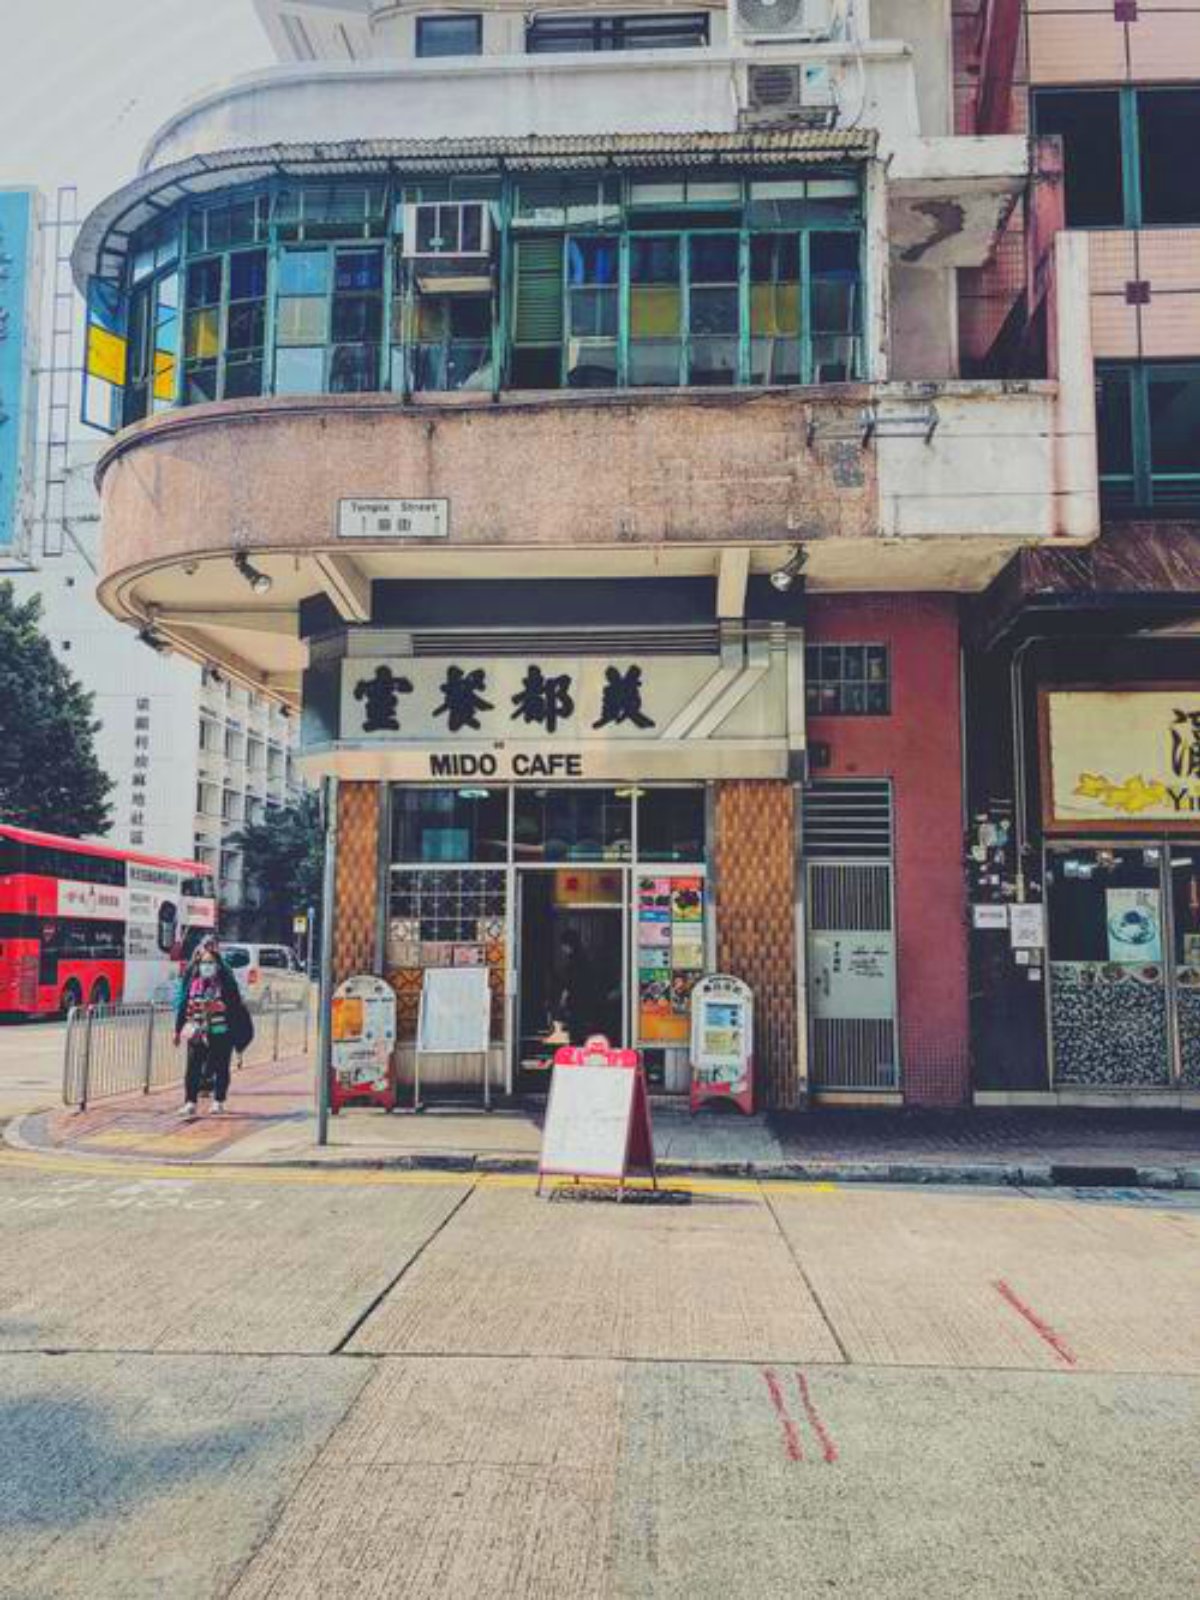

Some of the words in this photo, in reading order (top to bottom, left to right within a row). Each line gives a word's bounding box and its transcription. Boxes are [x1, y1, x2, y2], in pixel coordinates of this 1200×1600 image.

[401, 502, 438, 512] Street
[430, 754, 497, 776] MIDO
[512, 753, 582, 776] CAFE
